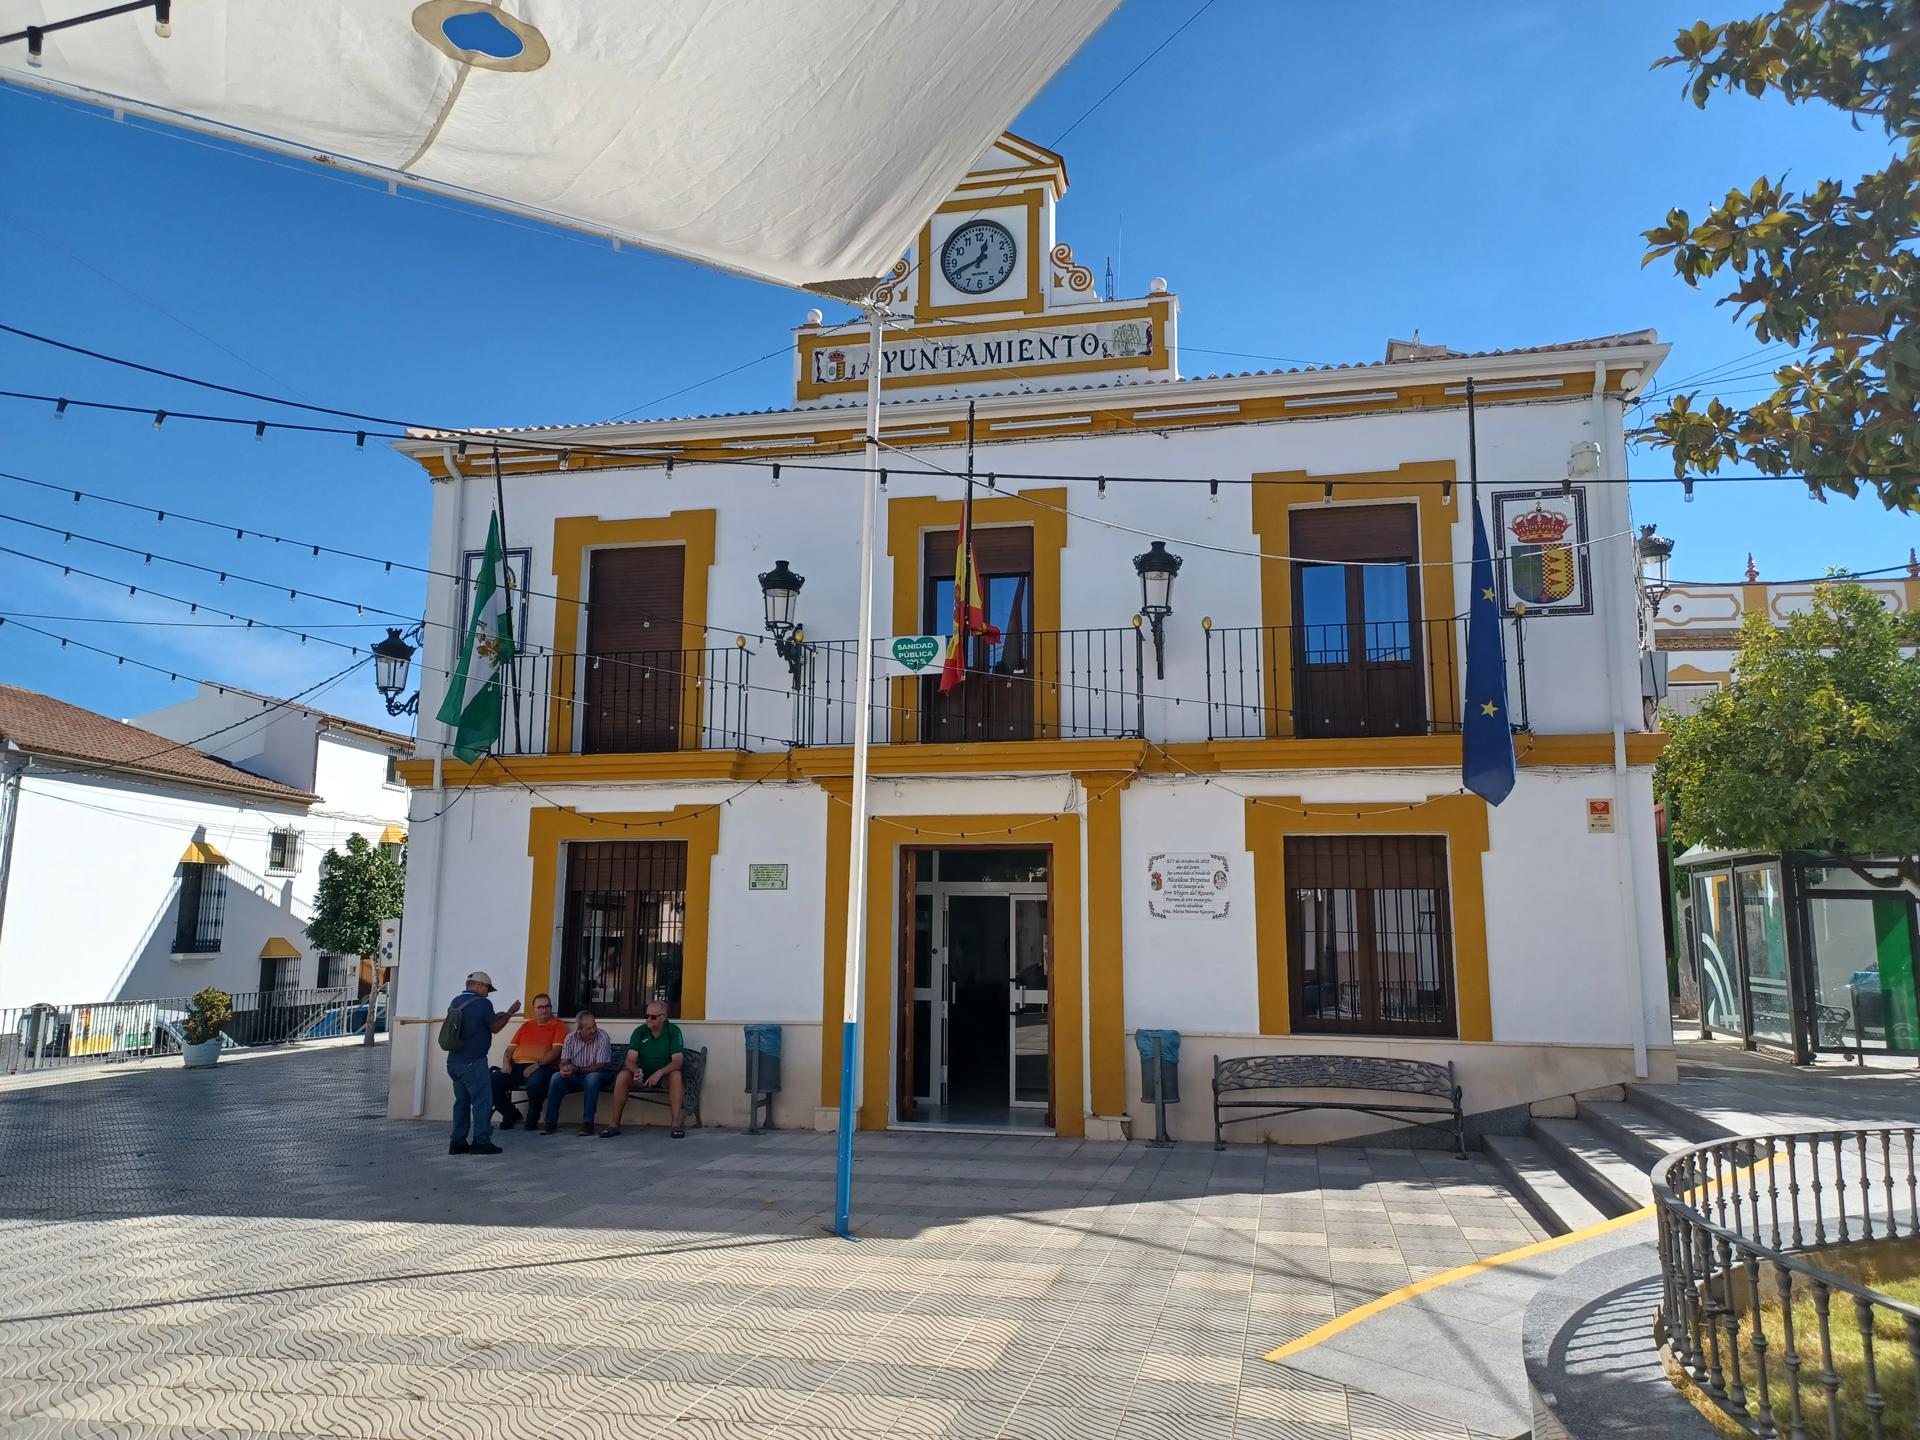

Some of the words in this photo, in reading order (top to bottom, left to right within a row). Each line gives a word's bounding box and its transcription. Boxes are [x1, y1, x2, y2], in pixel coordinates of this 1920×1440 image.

[975, 232, 984, 242] 12
[990, 234, 994, 242] 1
[964, 238, 971, 246] 11
[999, 241, 1004, 250] 2
[956, 247, 964, 256] 10
[1003, 254, 1008, 262] 3
[952, 259, 957, 267] 9
[998, 266, 1004, 275] 4
[966, 278, 971, 287] 7
[977, 280, 982, 288] 6
[989, 276, 994, 284] 5
